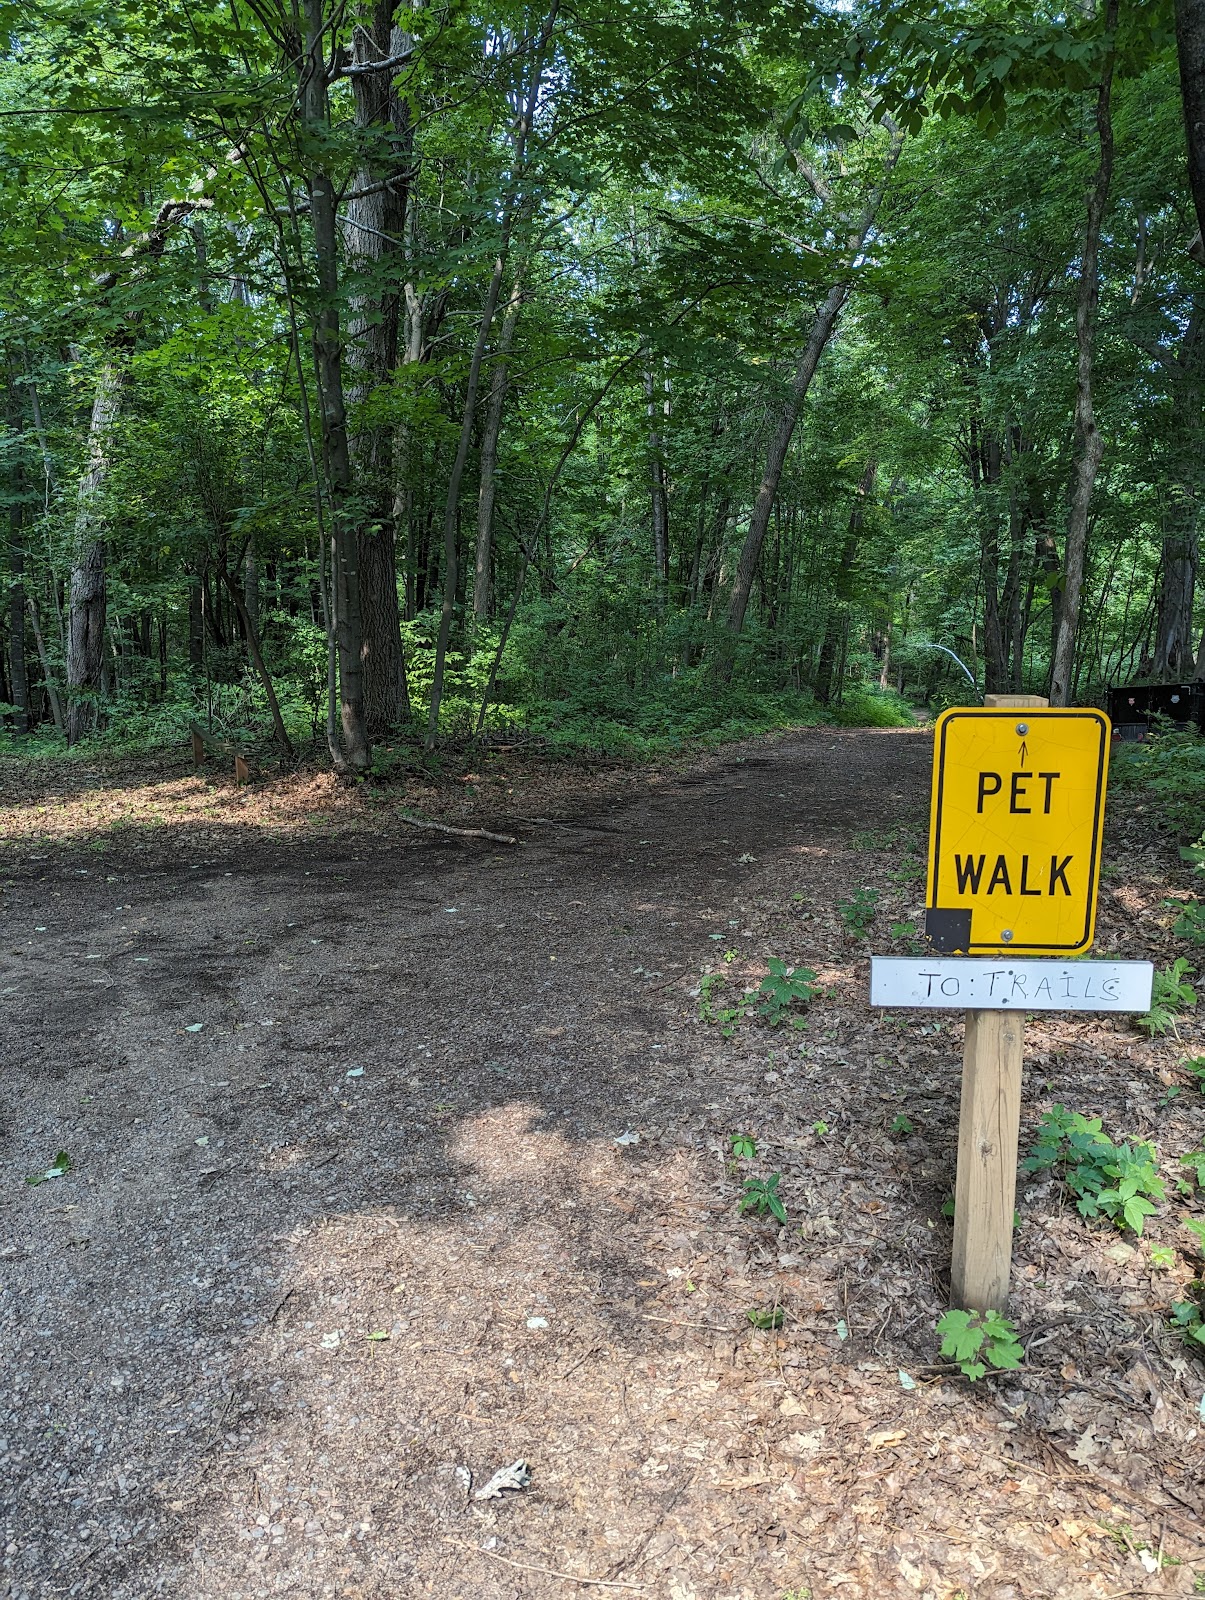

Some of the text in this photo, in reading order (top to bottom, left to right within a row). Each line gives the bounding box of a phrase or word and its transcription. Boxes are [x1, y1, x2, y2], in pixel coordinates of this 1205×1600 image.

[976, 771, 1061, 814] PET
[954, 854, 1074, 896] WALK
[983, 970, 1121, 1000] TRAILS
